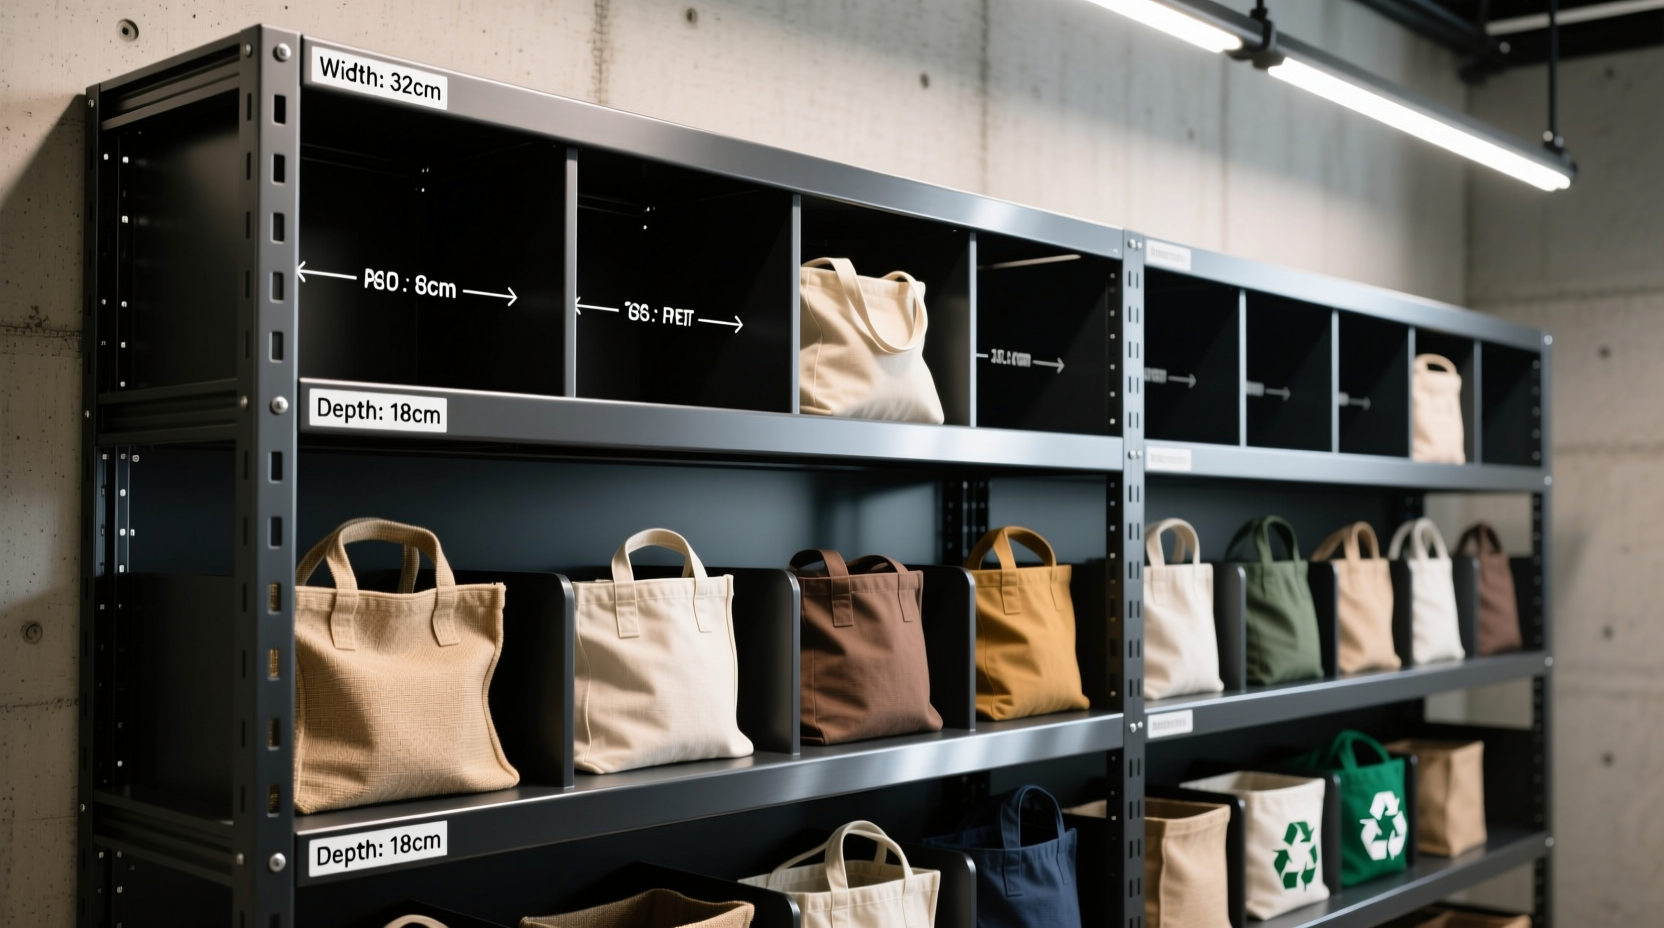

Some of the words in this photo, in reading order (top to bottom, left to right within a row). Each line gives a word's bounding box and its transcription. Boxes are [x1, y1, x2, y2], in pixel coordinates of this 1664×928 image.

[319, 55, 384, 89] Width:
[389, 71, 442, 101] 32cm
[414, 274, 457, 299] 8cm
[317, 397, 384, 424] Depth:
[390, 402, 441, 425] 18cm
[317, 839, 384, 868] Depth:
[390, 833, 441, 855] 18cm
